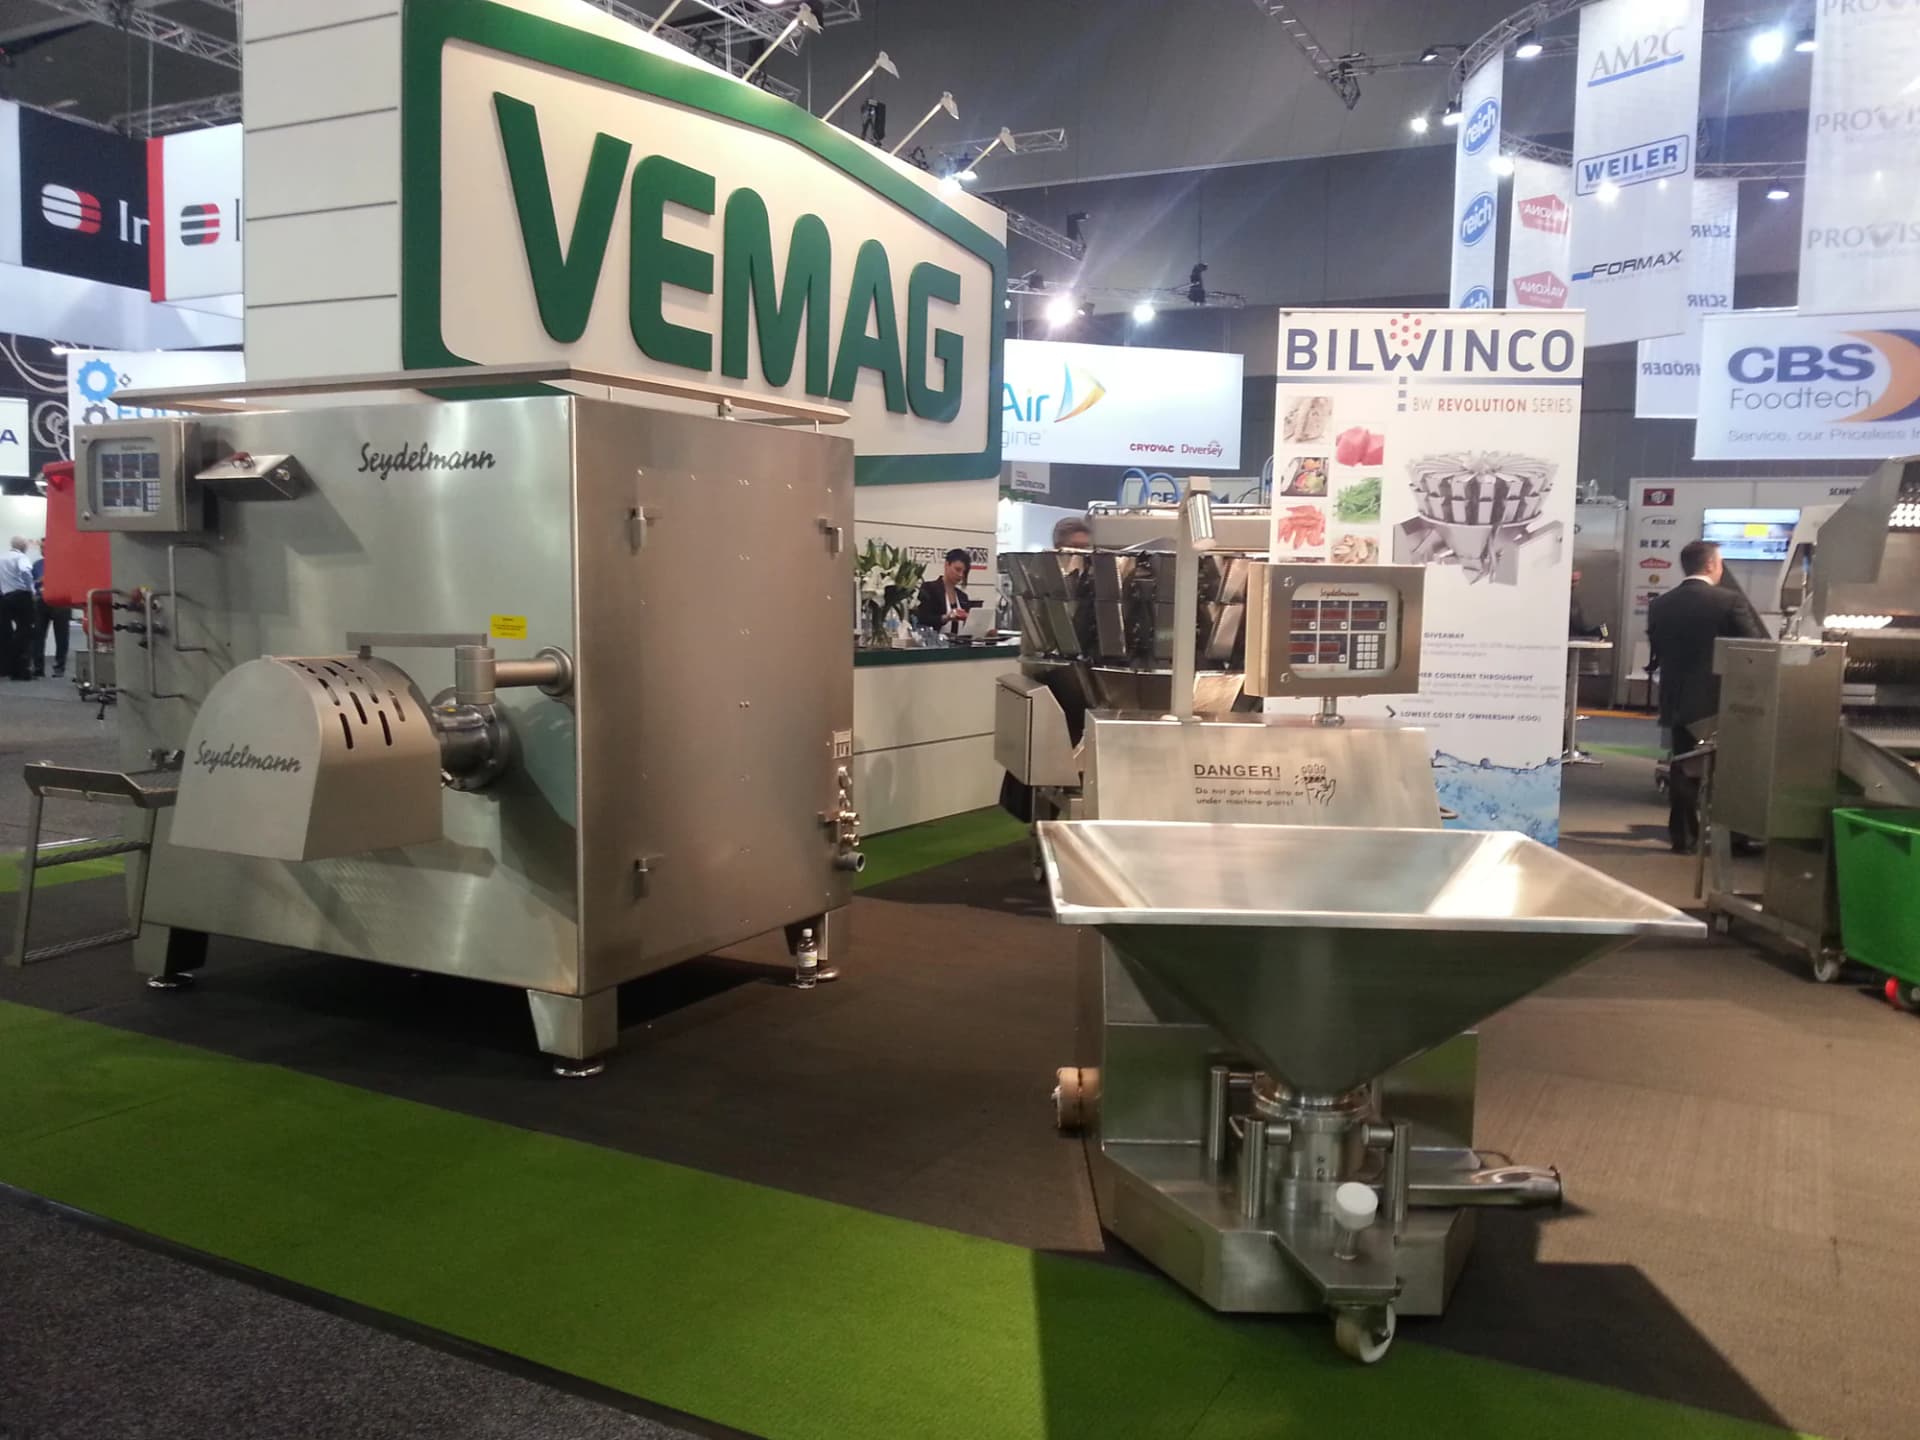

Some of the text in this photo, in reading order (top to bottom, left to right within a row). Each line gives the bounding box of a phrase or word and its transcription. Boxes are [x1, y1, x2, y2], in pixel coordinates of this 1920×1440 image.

[1590, 26, 1684, 80] AM2C
[1465, 103, 1496, 149] reich
[1584, 144, 1679, 183] WEILER
[1462, 200, 1493, 238] reich
[493, 91, 964, 424] VEMAG
[1591, 249, 1683, 276] FORMAX
[1286, 328, 1575, 373] BILWINCO
[1727, 343, 1876, 384] CBS
[1437, 397, 1527, 413] REVOLUTION
[1532, 397, 1574, 414] SERIES
[1730, 385, 1872, 411] Foodtech
[357, 441, 497, 481] Seydelmann
[1129, 442, 1224, 458] CRYOVAC Diversey
[1640, 539, 1671, 549] REX
[1434, 672, 1477, 681] CONSTANT
[1479, 673, 1534, 682] THROUGHPUT
[1400, 711, 1431, 719] LOWEST
[1433, 711, 1453, 720] COST
[1468, 713, 1516, 722] OWNERSHIP
[194, 739, 303, 775] Seydelmann
[1193, 763, 1281, 778] DANGER!
